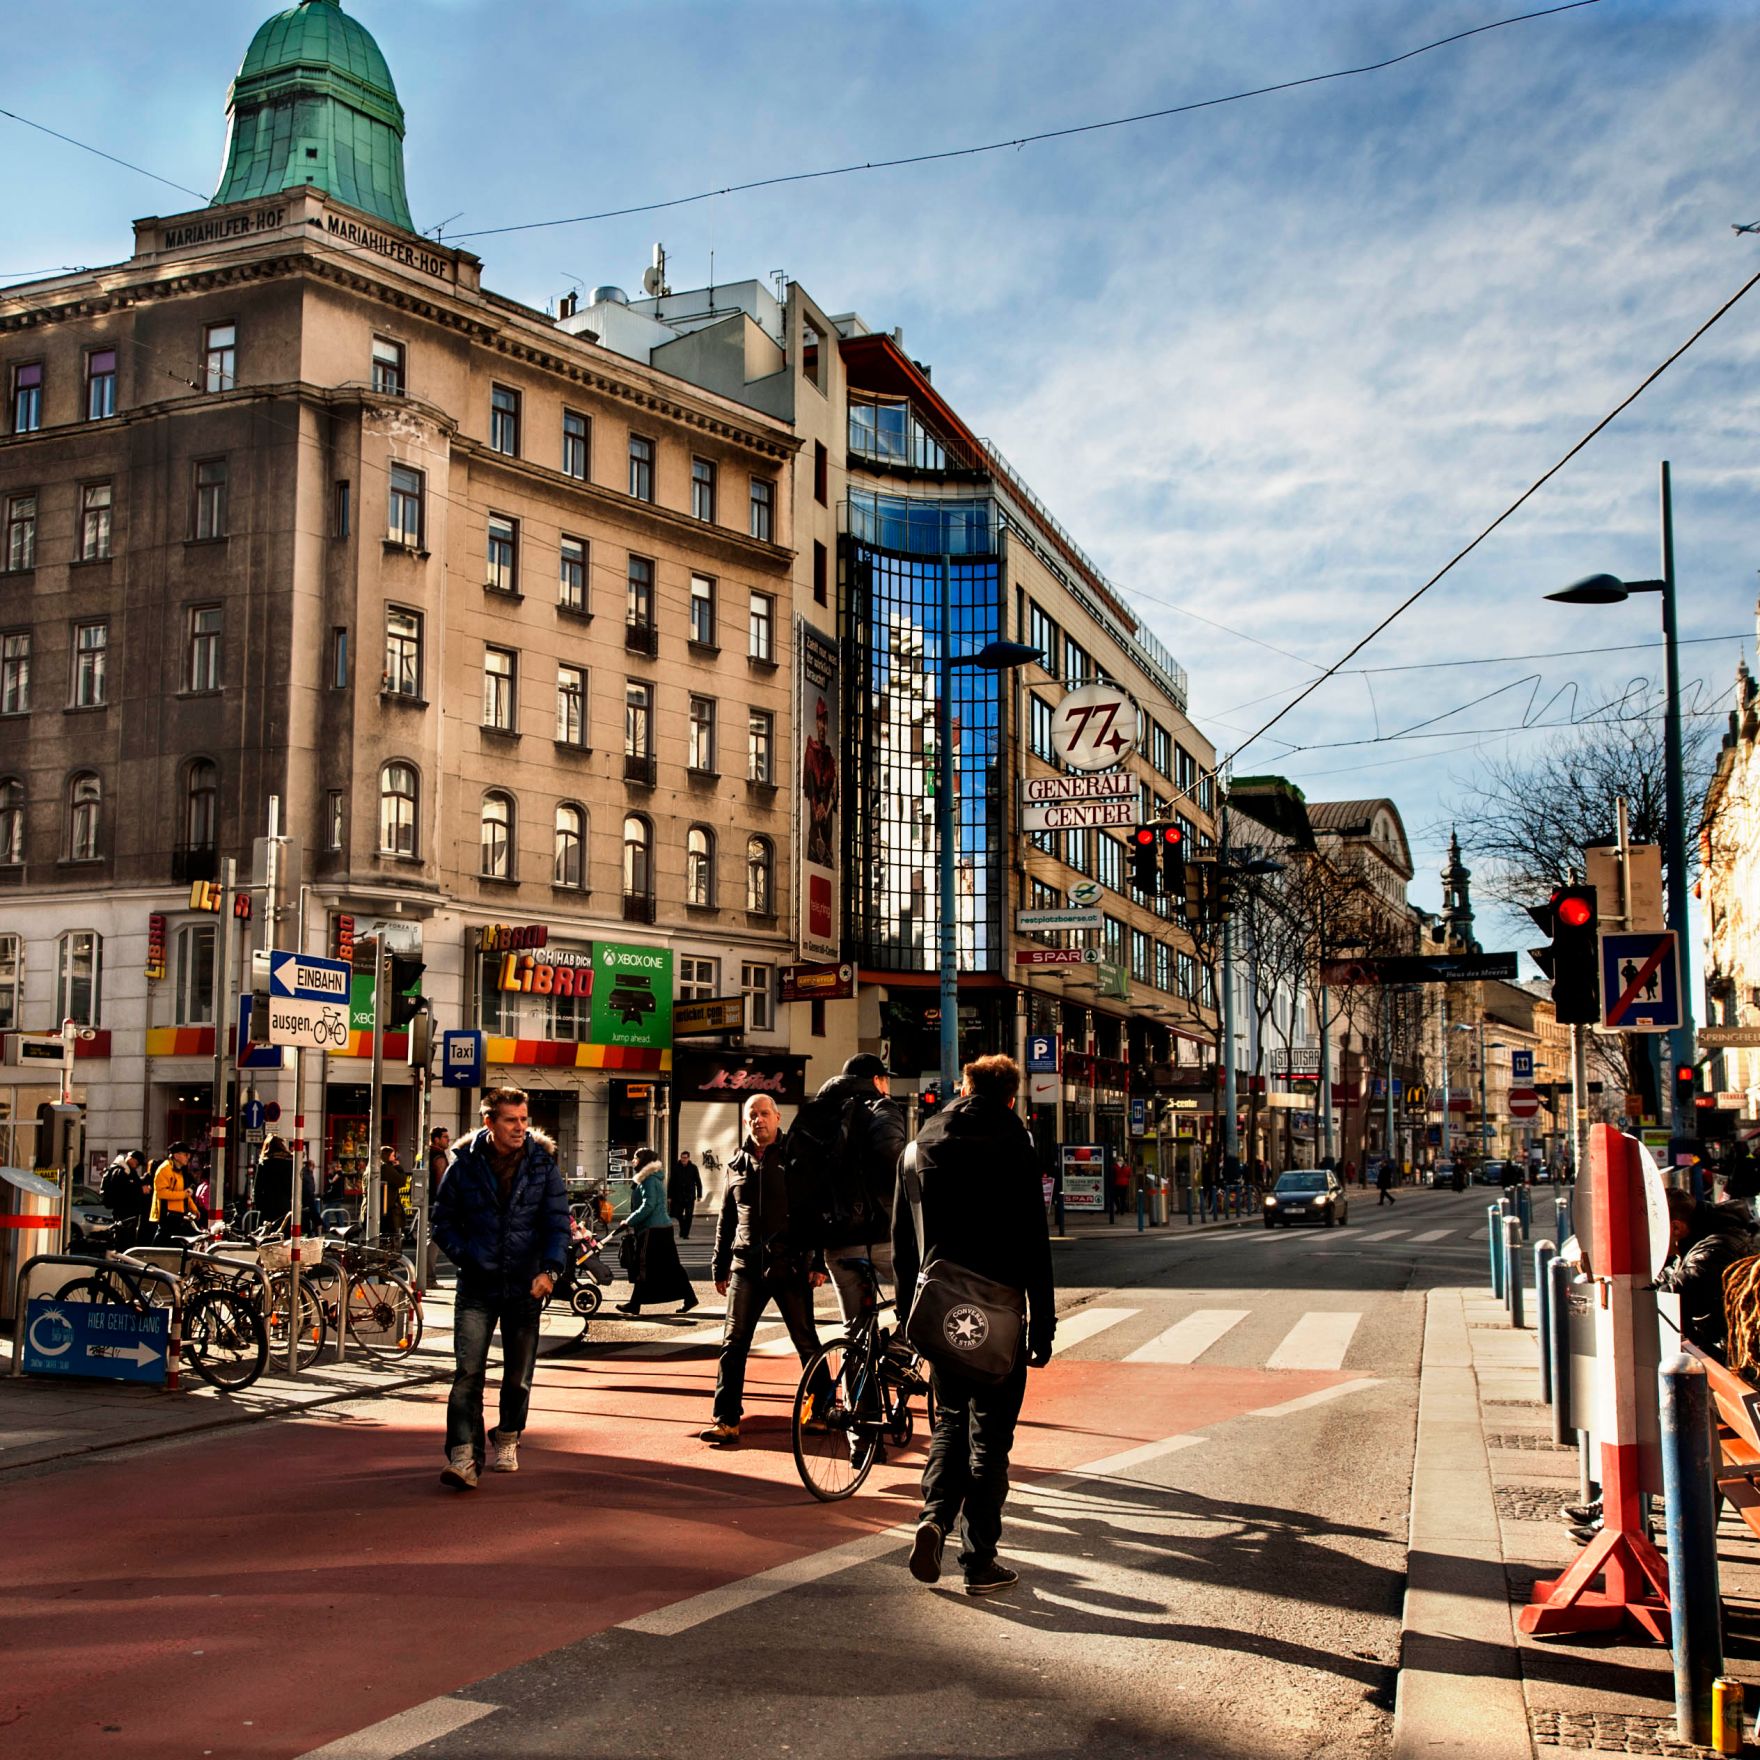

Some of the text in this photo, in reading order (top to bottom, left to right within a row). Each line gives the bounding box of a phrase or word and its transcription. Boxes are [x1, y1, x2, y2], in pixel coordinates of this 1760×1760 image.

[165, 208, 285, 250] MARIAHILFER-HOF
[327, 214, 449, 278] MARIAHILFER-HOF
[1065, 702, 1121, 752] 77
[1028, 774, 1133, 800] GENERALI
[1044, 803, 1132, 828] CENTER
[556, 951, 575, 967] HAB
[575, 955, 592, 967] DICH
[617, 953, 663, 969] XBOX ONE
[1032, 951, 1081, 963] SPAR
[297, 967, 343, 992] EINBAHN
[272, 1013, 314, 1035] ausgen.
[611, 1032, 633, 1044] Jump
[450, 1043, 474, 1059] Taxi
[1033, 1043, 1048, 1060] P
[87, 1311, 161, 1334] HIER GEHT'S LANG
[952, 1308, 985, 1326] CONVERSE
[948, 1330, 959, 1343] ALL
[958, 1339, 977, 1347] STAR
